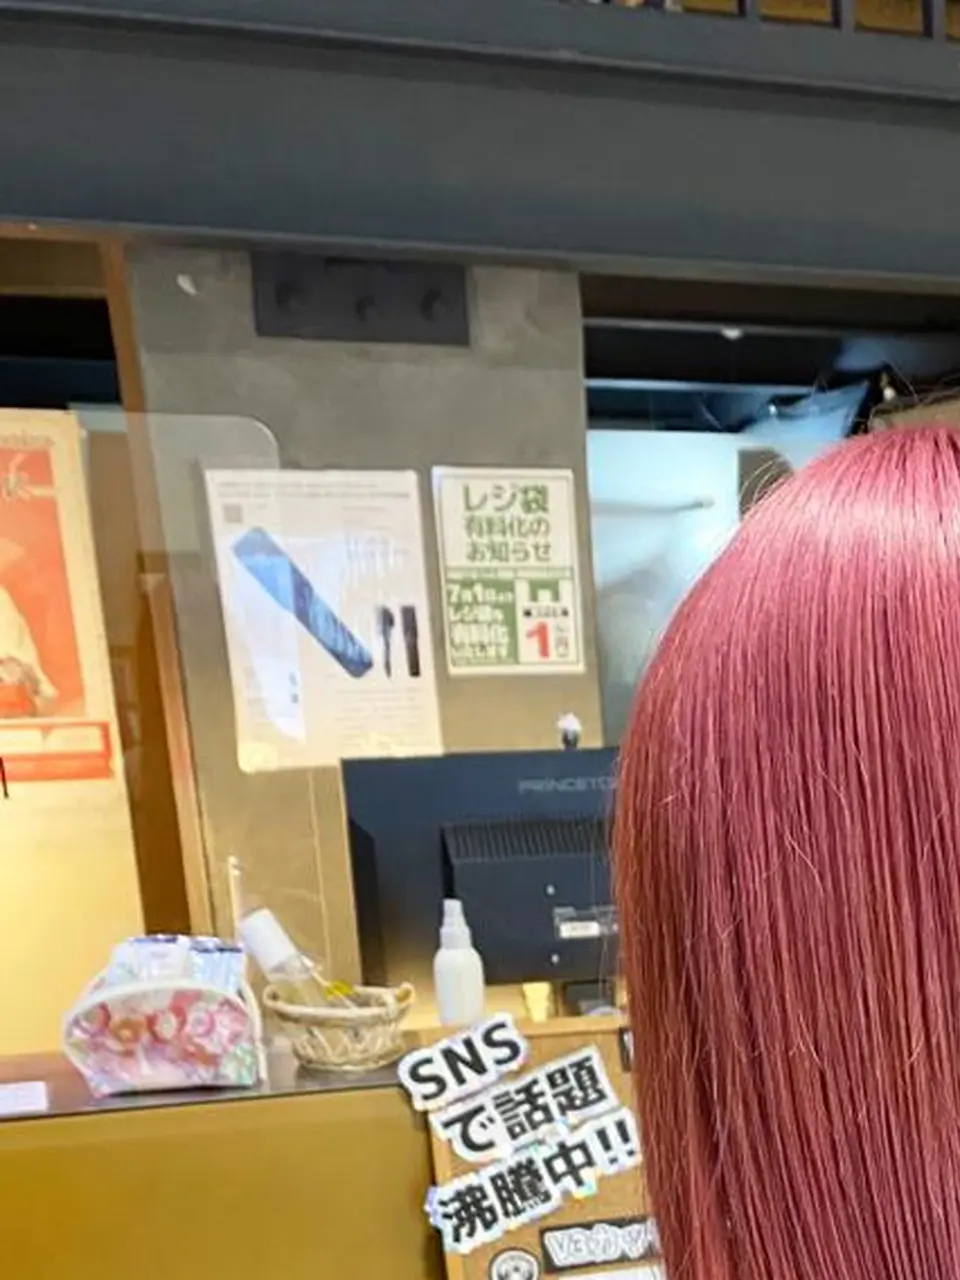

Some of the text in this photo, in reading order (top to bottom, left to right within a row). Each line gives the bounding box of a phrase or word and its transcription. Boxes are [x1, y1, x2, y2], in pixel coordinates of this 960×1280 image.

[462, 482, 549, 514] レジ袋
[465, 514, 551, 539] 有料化の
[466, 540, 552, 563] お知らせ
[408, 1021, 521, 1101] SNS
[441, 1055, 609, 1153] で話題
[438, 1118, 636, 1244] 沸騰中!!
